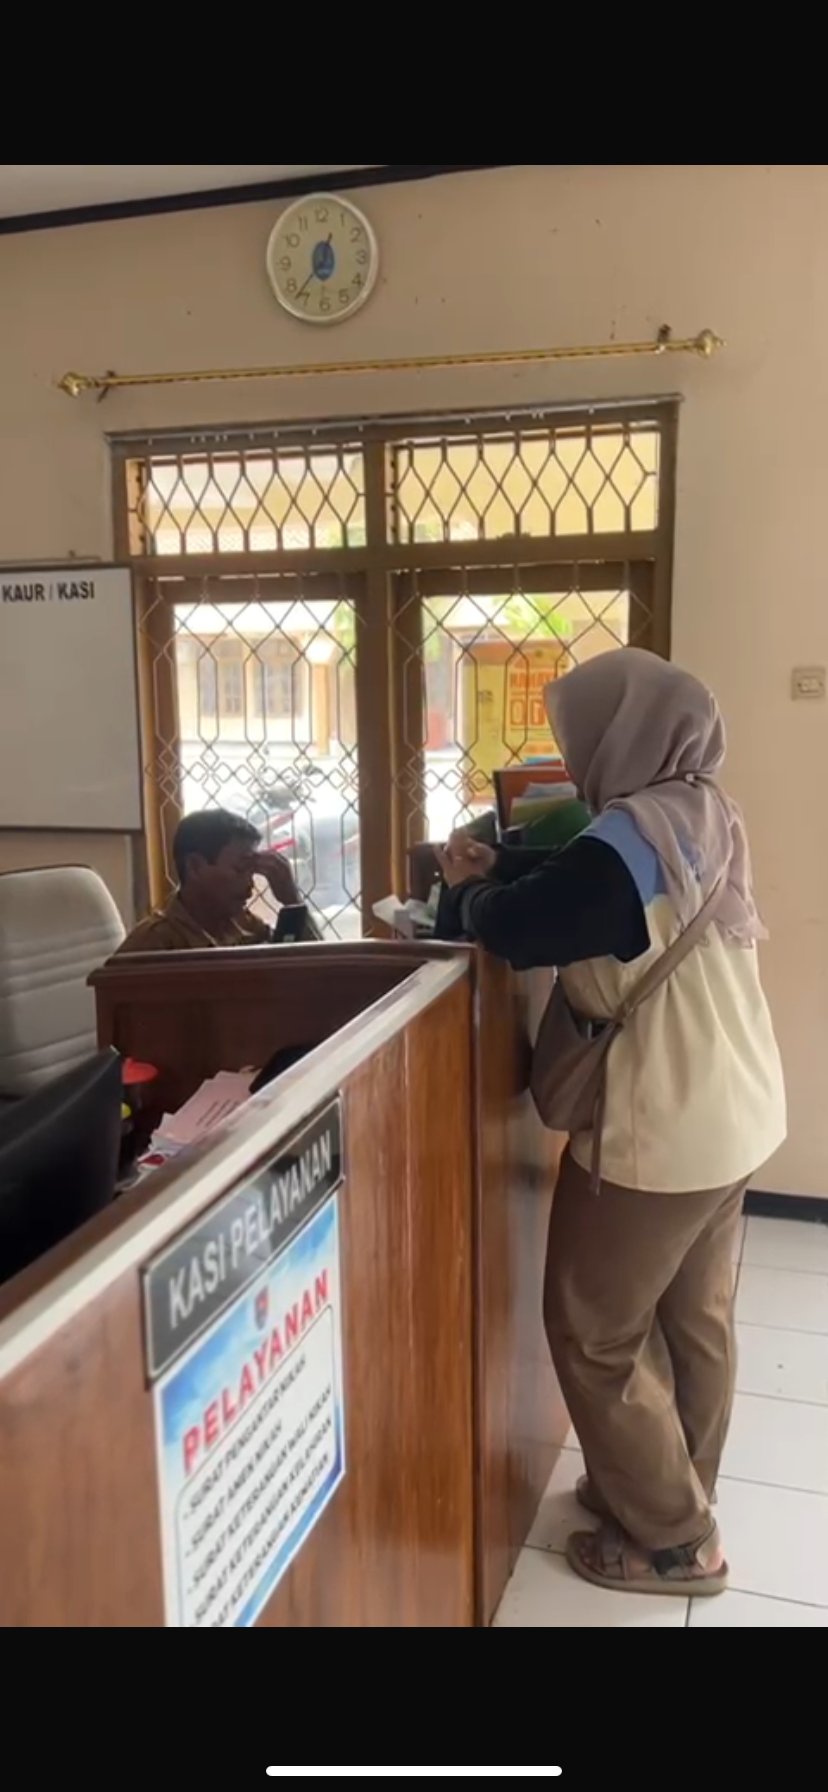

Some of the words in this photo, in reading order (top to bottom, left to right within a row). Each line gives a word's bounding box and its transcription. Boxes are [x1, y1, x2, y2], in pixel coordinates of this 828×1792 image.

[314, 208, 328, 222] 12
[284, 233, 300, 248] 10
[350, 227, 361, 242] 2
[280, 256, 291, 271] 9
[355, 250, 367, 264] 3
[286, 278, 297, 293] 8
[351, 272, 362, 287] 4
[338, 288, 350, 304] 5
[319, 296, 330, 312] 6
[2, 583, 45, 602] KAUR
[57, 581, 95, 600] KASI
[169, 1233, 226, 1328] KASI
[229, 1130, 331, 1269] PELAYANAN
[183, 1268, 328, 1476] PELAYANAN
